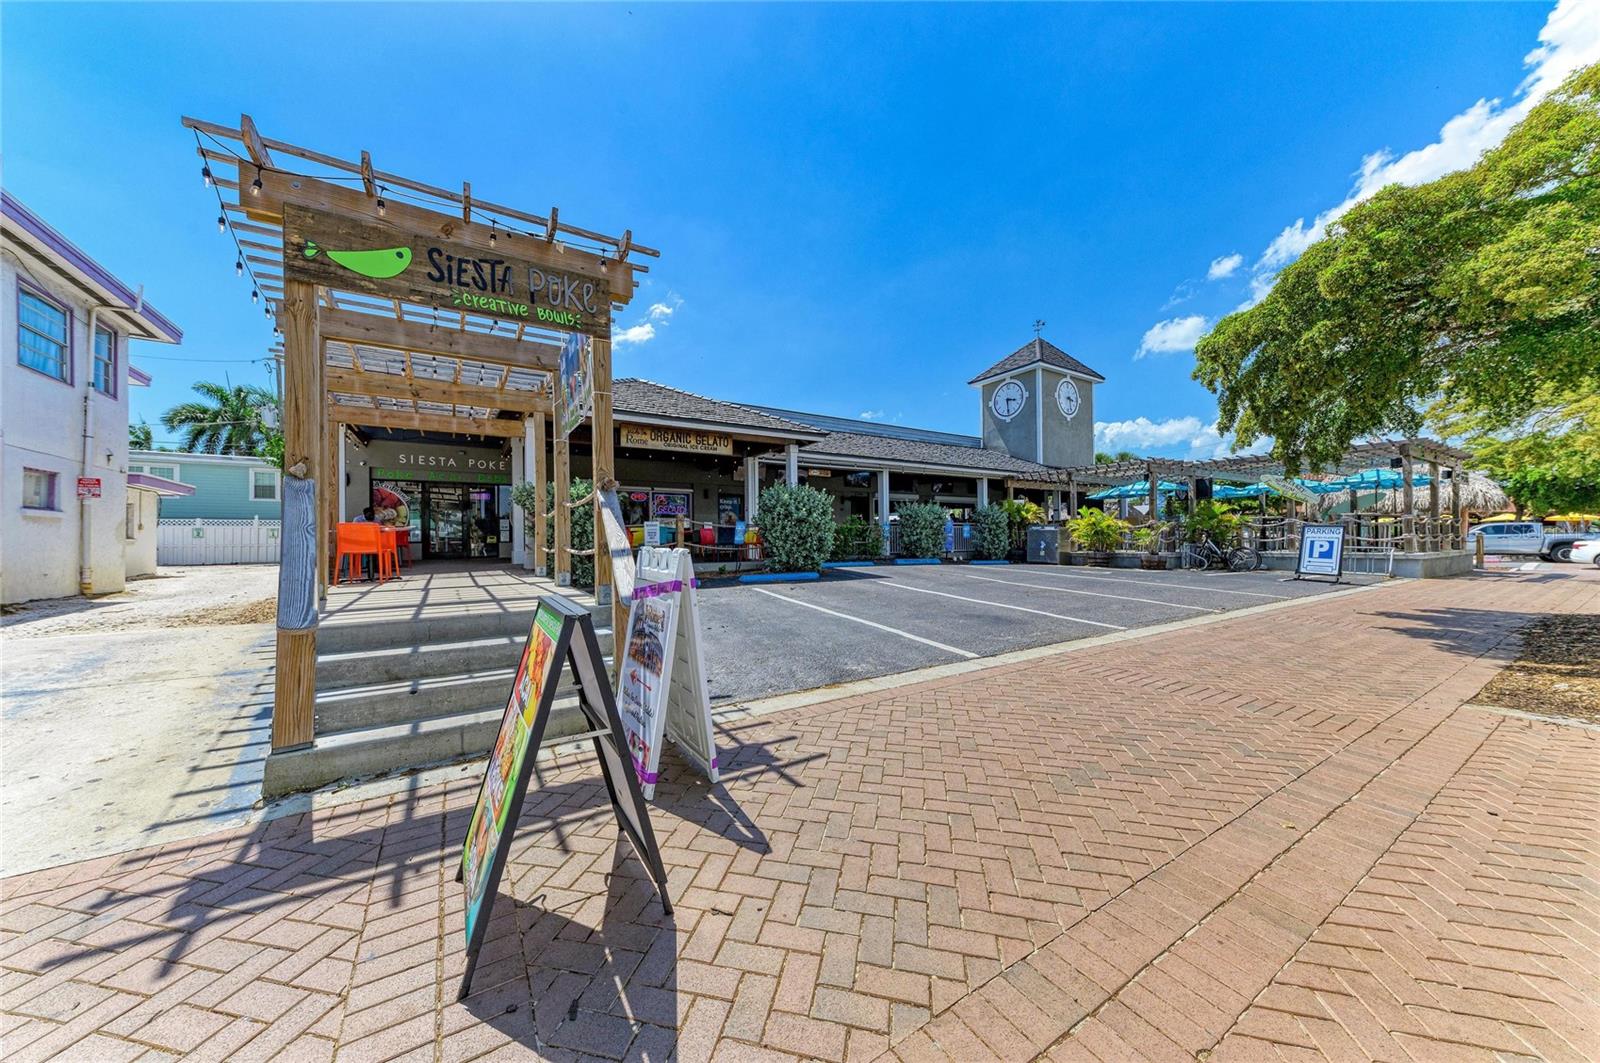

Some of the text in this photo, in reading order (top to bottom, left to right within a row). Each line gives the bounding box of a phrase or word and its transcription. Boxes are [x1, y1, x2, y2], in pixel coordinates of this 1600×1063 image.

[650, 430, 691, 445] ORGANIC
[695, 434, 729, 448] GELATO
[663, 441, 689, 449] ORIGINAL
[399, 454, 506, 471] SIESTA POKE
[1306, 527, 1341, 536] PARKING
[1312, 540, 1330, 558] P
